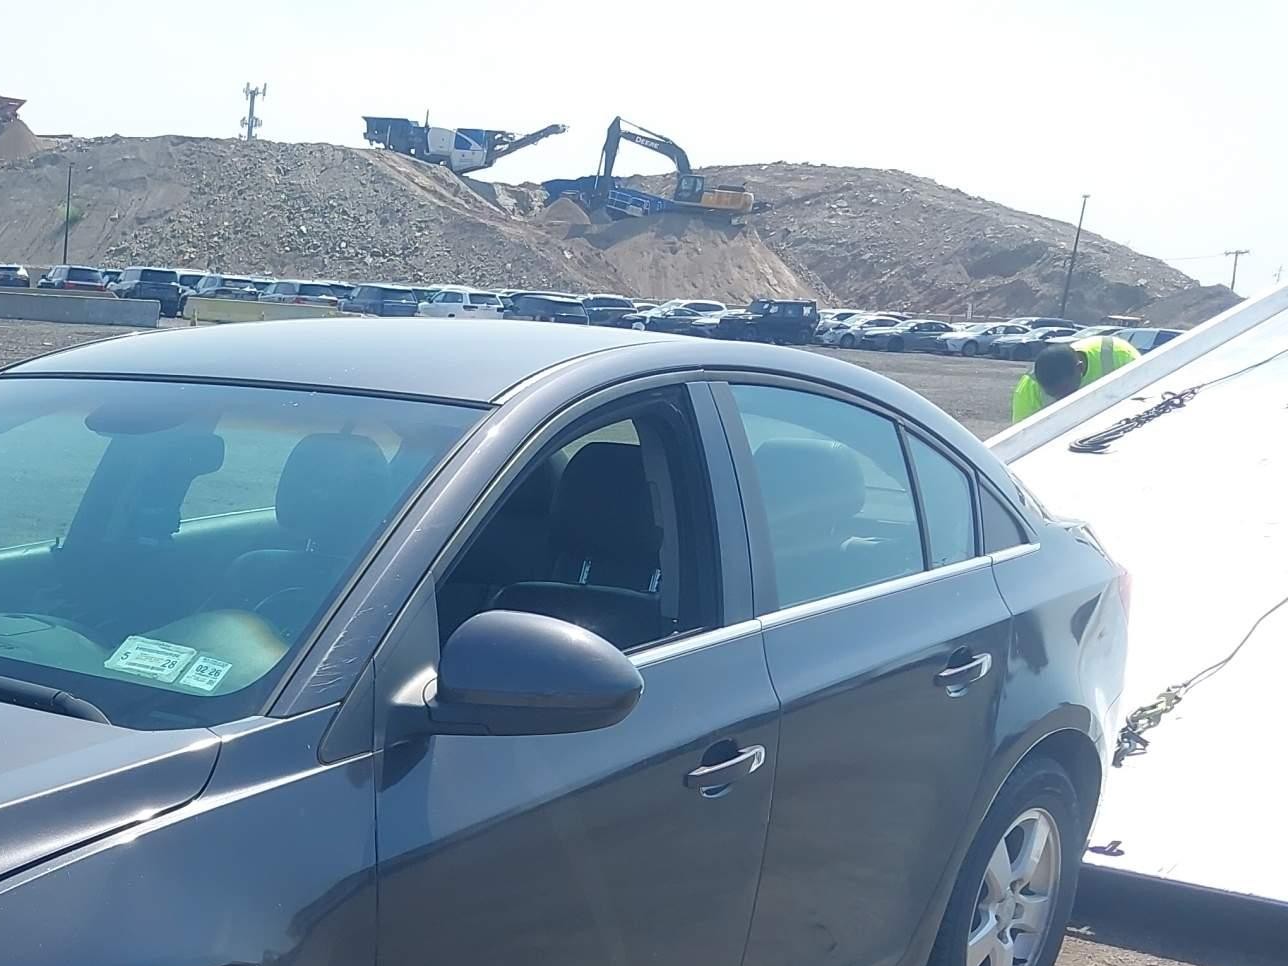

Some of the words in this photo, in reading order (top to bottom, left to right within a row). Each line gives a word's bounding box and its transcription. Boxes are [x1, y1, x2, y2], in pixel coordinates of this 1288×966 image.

[636, 136, 659, 149] DEERE
[120, 651, 132, 661] 5
[160, 659, 178, 669] 28
[196, 664, 209, 674] 02
[208, 668, 222, 678] 26
